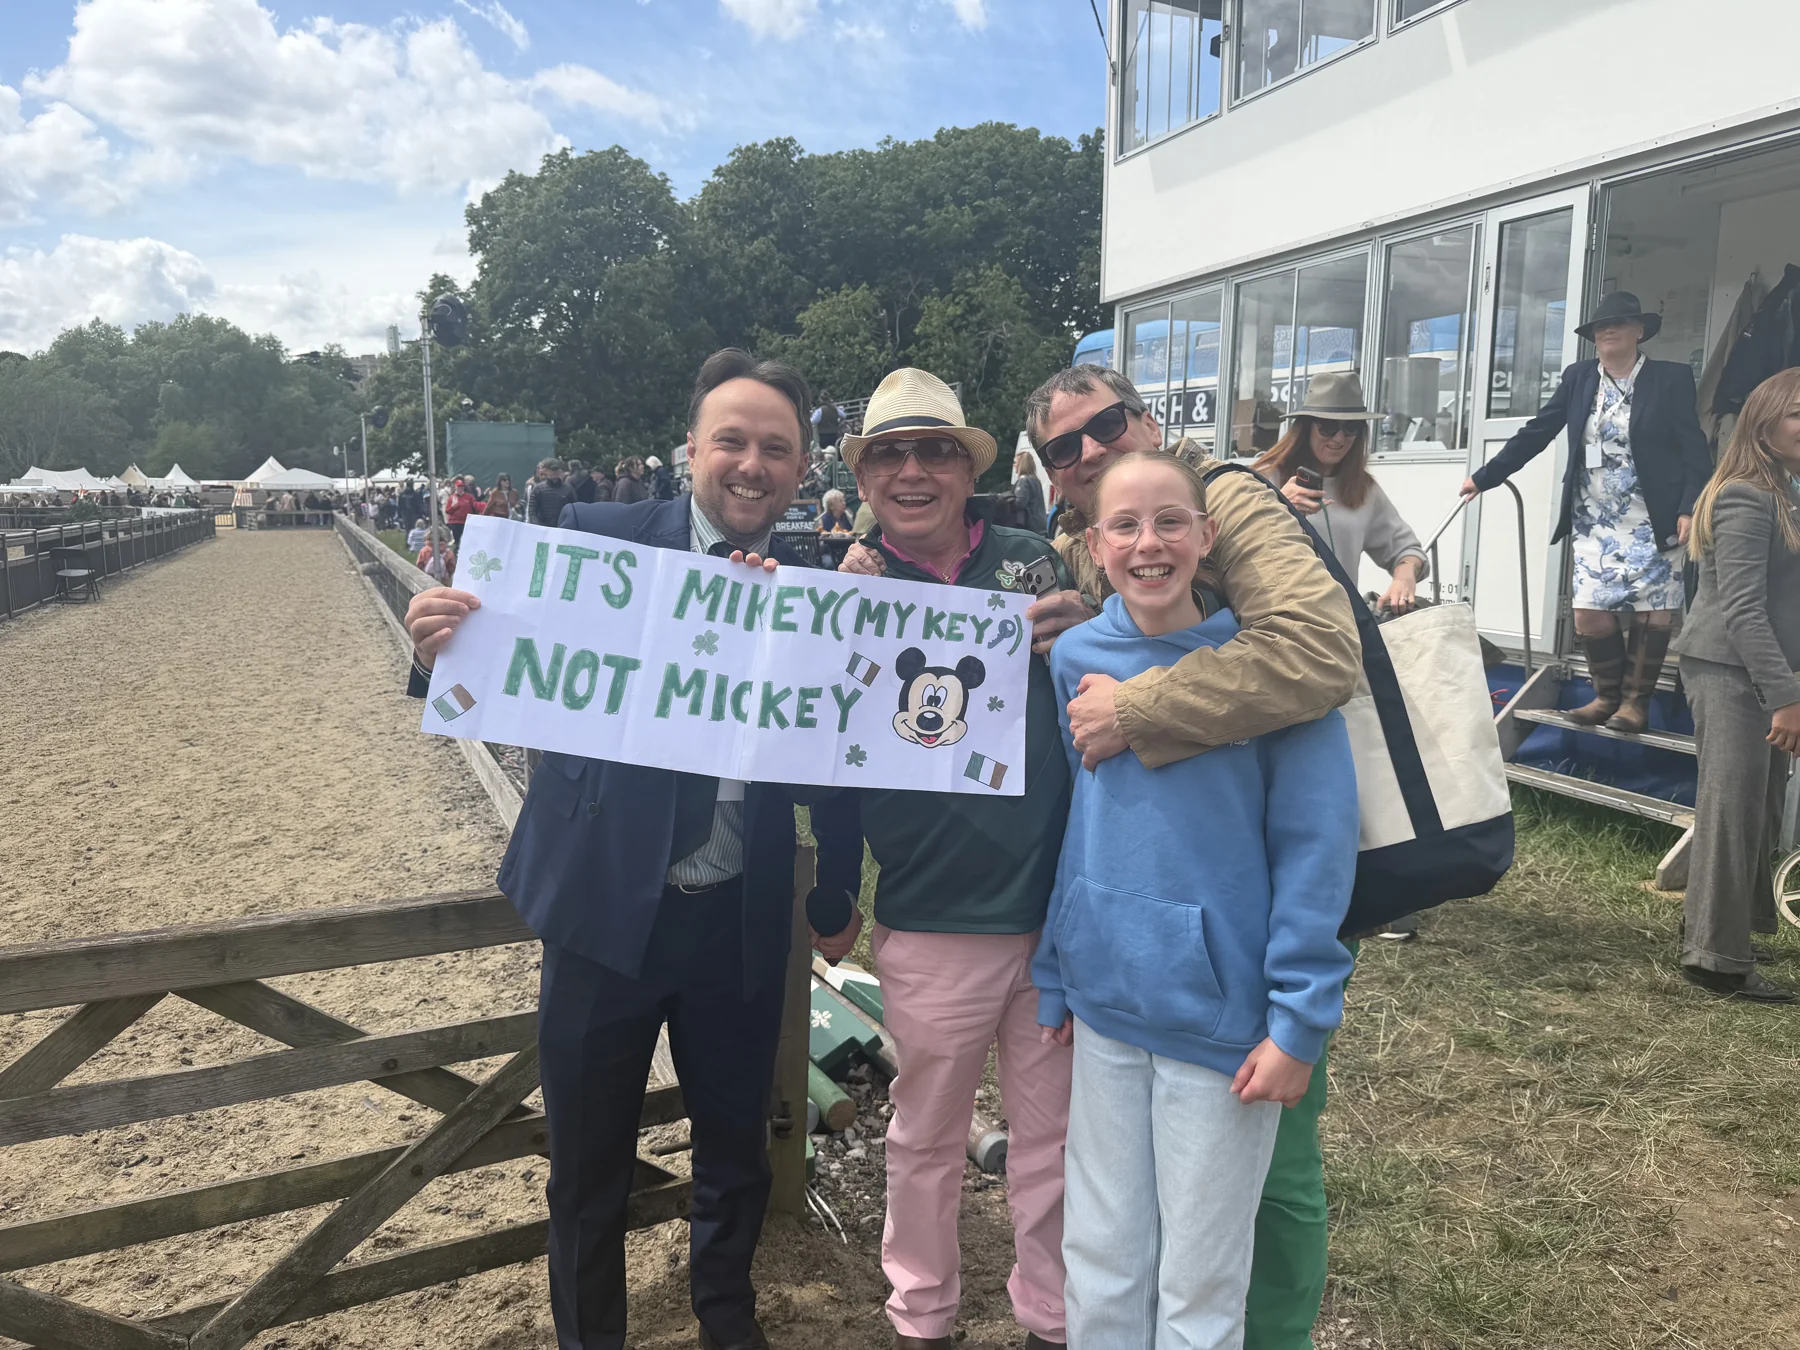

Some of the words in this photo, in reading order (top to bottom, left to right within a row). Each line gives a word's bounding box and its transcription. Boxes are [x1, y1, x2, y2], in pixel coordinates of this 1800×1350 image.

[1192, 392, 1209, 422] &
[776, 521, 816, 532] BREAKFAS
[527, 541, 638, 610] IT'S
[502, 637, 641, 716] NOT
[654, 661, 864, 734] MICKEY
